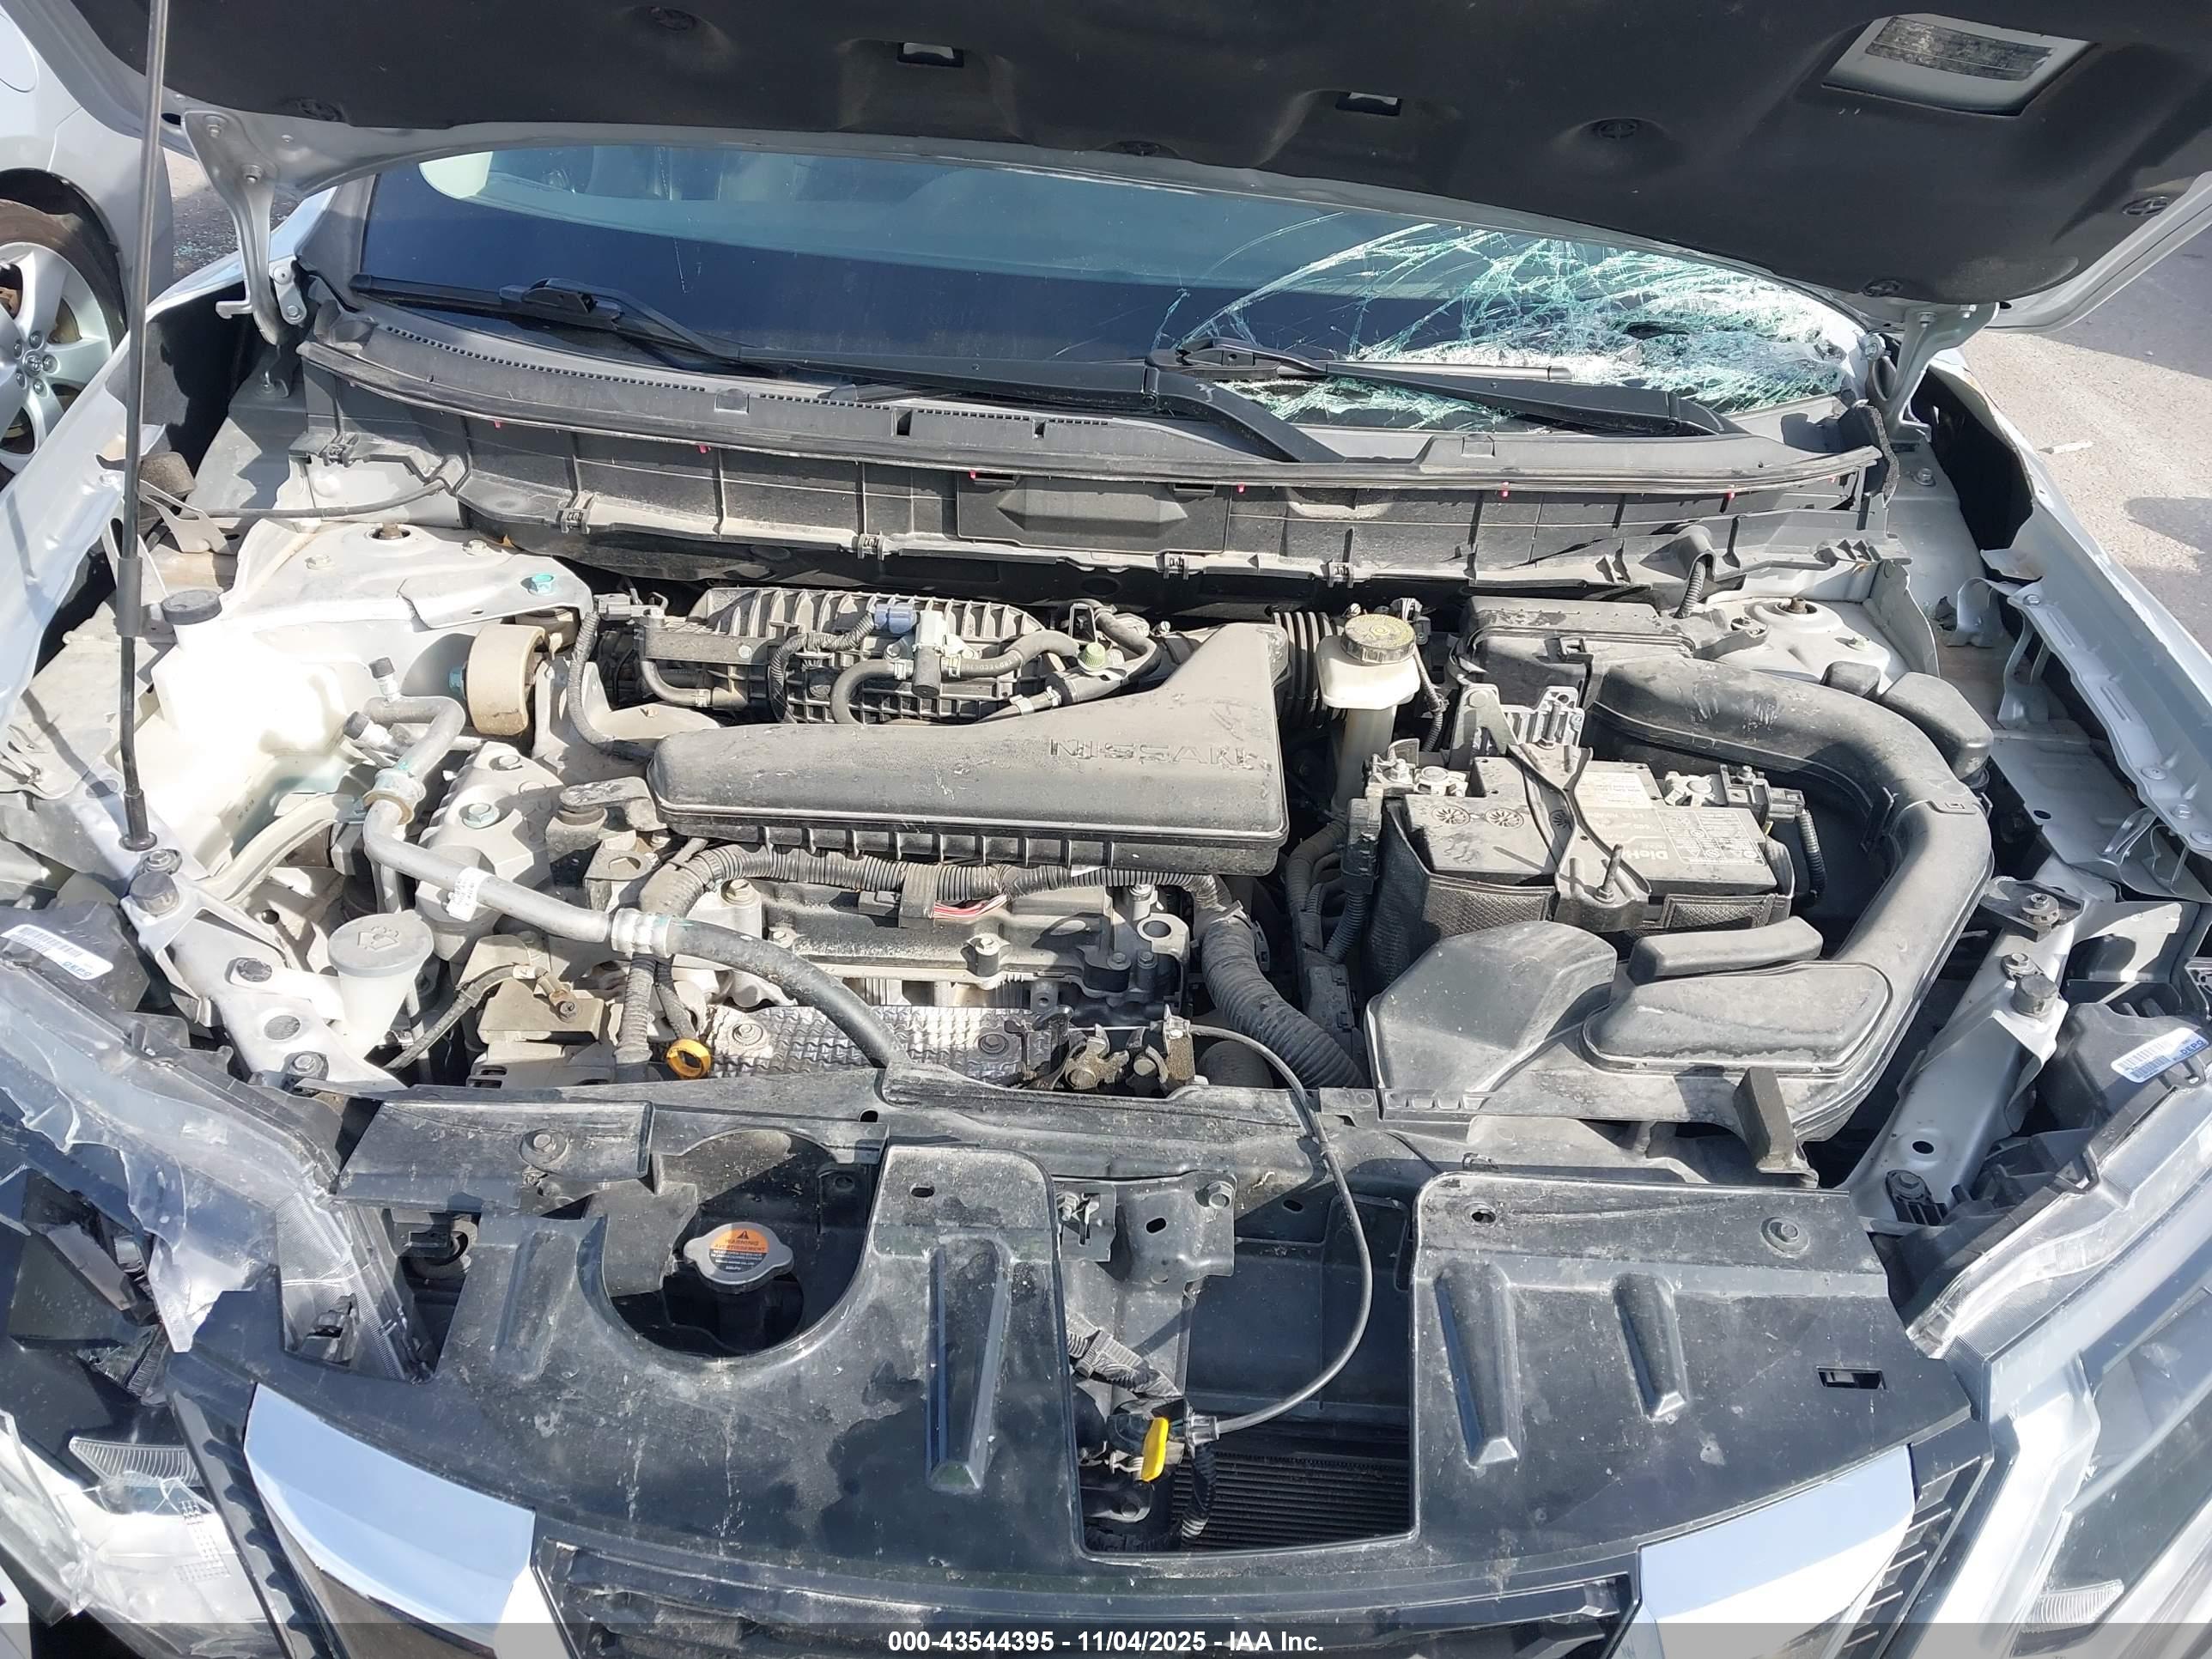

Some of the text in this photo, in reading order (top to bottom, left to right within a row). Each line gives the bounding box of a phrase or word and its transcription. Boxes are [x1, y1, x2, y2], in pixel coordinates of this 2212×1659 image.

[1050, 738, 1244, 767] NISSAN
[62, 961, 92, 977] DEPO
[2179, 1038, 2205, 1056] DEPO
